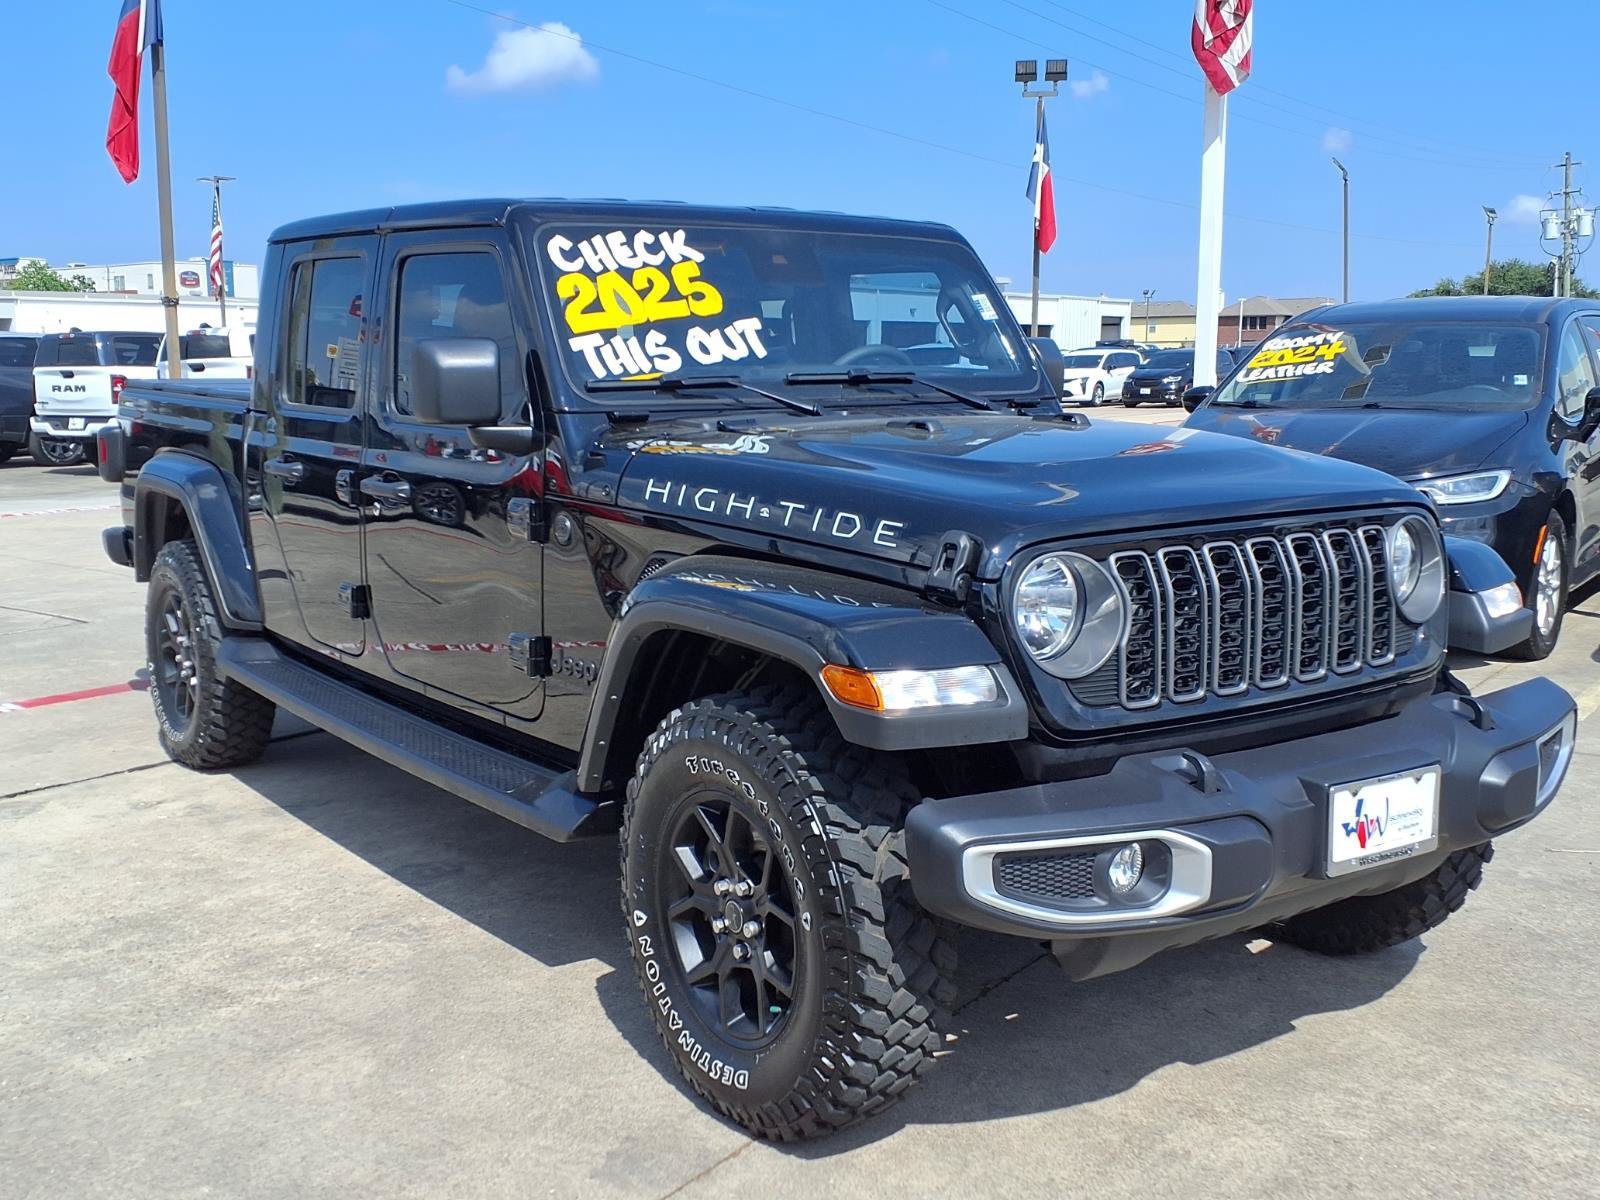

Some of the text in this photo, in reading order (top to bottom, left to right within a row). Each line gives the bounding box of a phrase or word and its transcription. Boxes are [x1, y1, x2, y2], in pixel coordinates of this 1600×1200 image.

[547, 229, 705, 273] CHECK
[556, 261, 723, 334] 2025
[568, 318, 768, 379] THIS OUT
[1247, 340, 1347, 369] 2024
[1262, 331, 1345, 352] ROOMY
[51, 384, 86, 393] RAM
[1236, 361, 1335, 383] LEATHER
[644, 478, 904, 548] HIGH TIDE
[551, 649, 596, 686] Jeep
[638, 935, 750, 1091] DESTINATION
